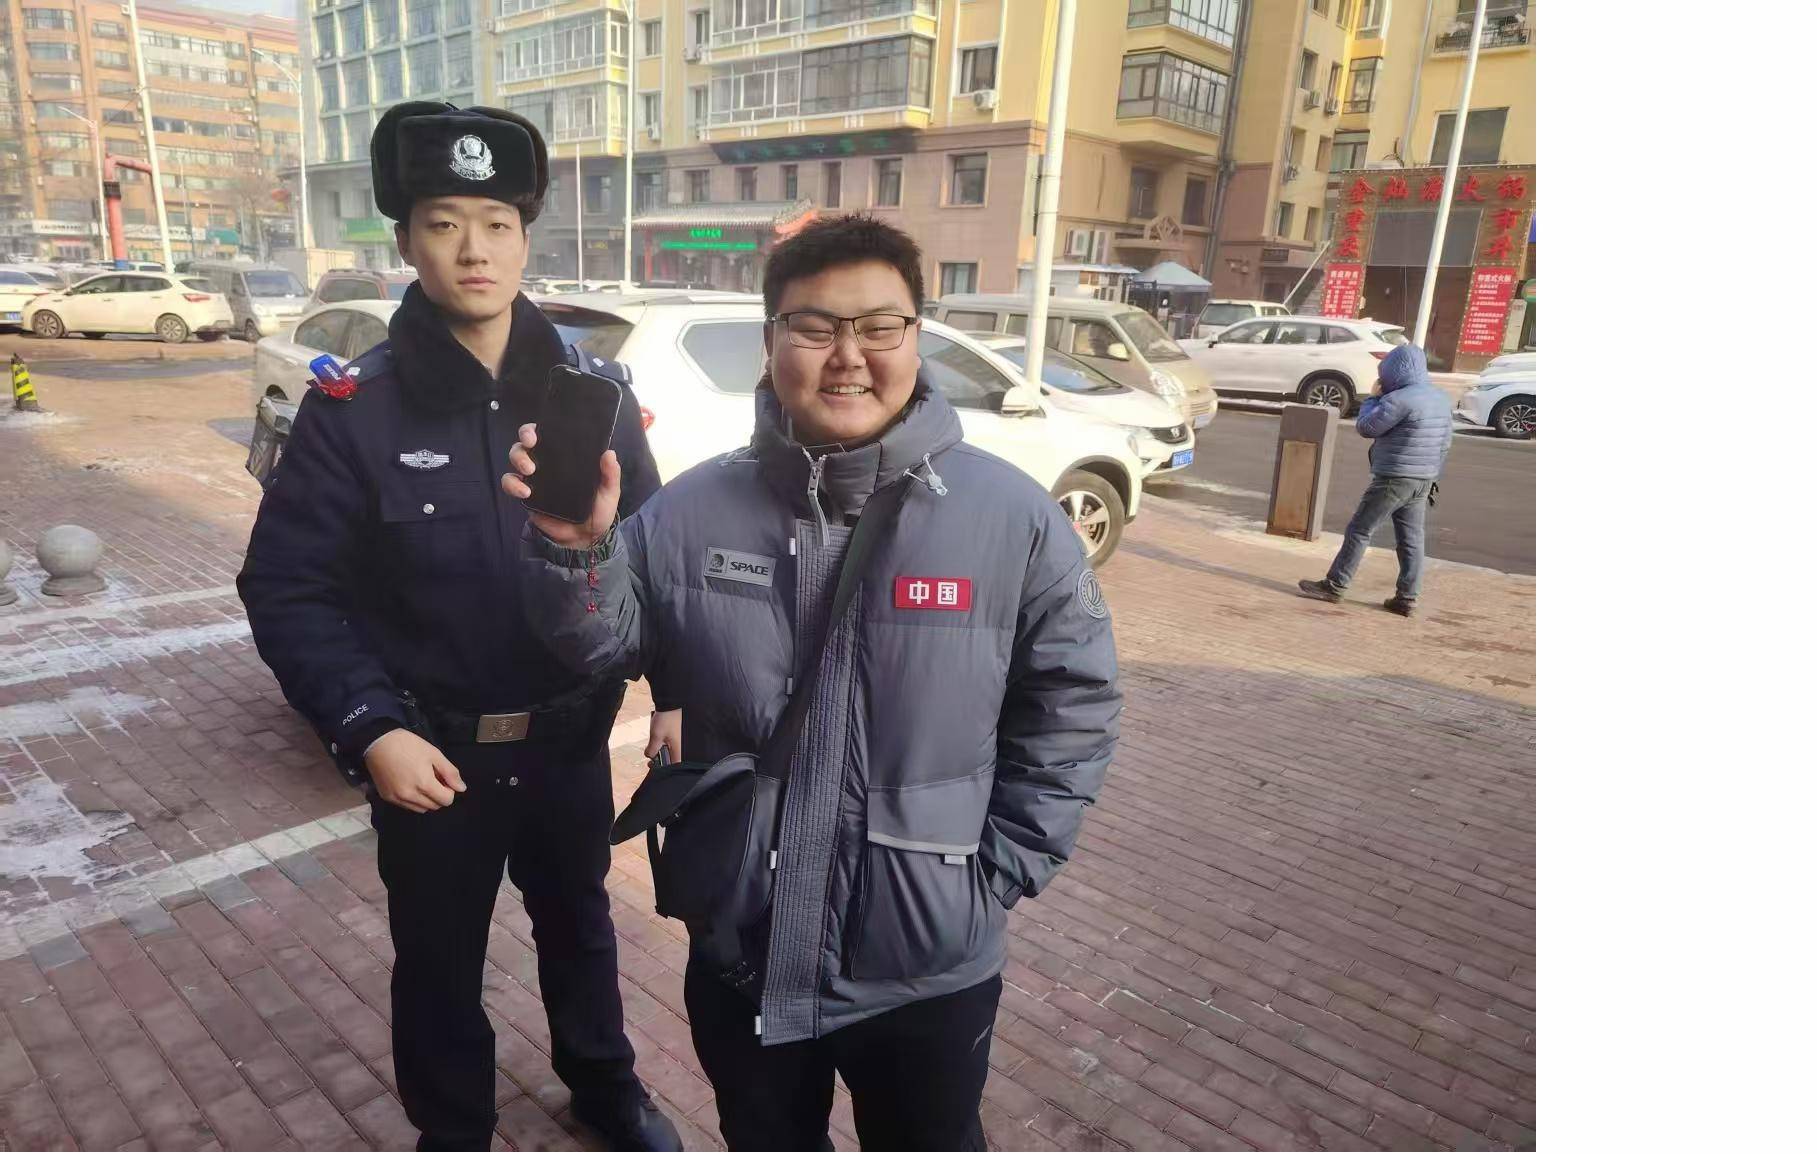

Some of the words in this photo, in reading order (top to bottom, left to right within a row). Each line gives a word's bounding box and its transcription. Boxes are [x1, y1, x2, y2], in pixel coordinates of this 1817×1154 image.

[730, 561, 769, 576] SPACE
[908, 580, 958, 605] 中国
[342, 703, 369, 726] POLICE
